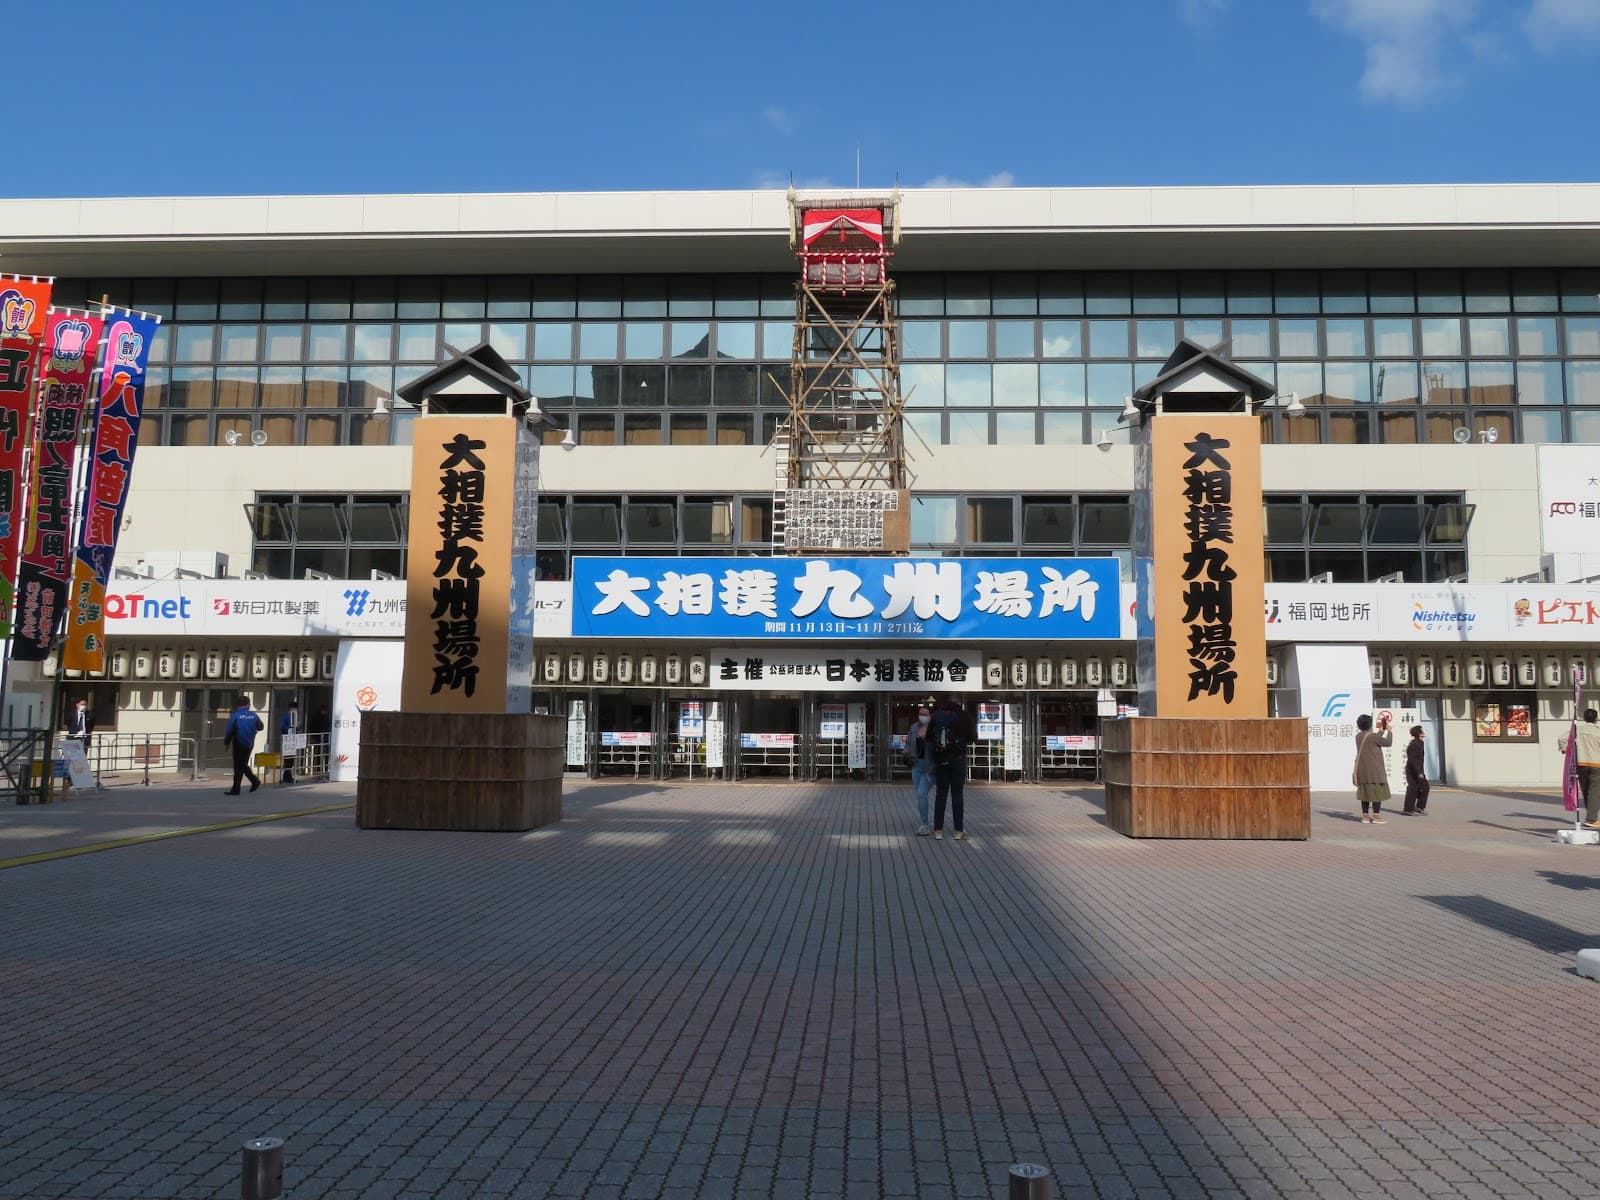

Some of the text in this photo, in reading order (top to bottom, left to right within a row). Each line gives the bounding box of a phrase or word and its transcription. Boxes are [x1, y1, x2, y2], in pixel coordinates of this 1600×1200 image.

[1578, 502, 1600, 518] 福
[430, 433, 487, 698] 大相撲九州場所
[1182, 432, 1237, 704] 大相撲九州場所
[591, 560, 1100, 622] 大相撲九州場所
[104, 595, 191, 619] QTnet
[232, 599, 320, 616] 新日本製薬
[1288, 602, 1371, 622] 福岡地所
[1413, 610, 1476, 622] Nishitetsu
[1426, 623, 1473, 631] Group
[720, 658, 970, 682] 主催 公益財団法人 日本相撲協會
[990, 667, 1001, 678] 西
[334, 719, 360, 728] 西日本
[1308, 723, 1358, 738] 福岡銀
